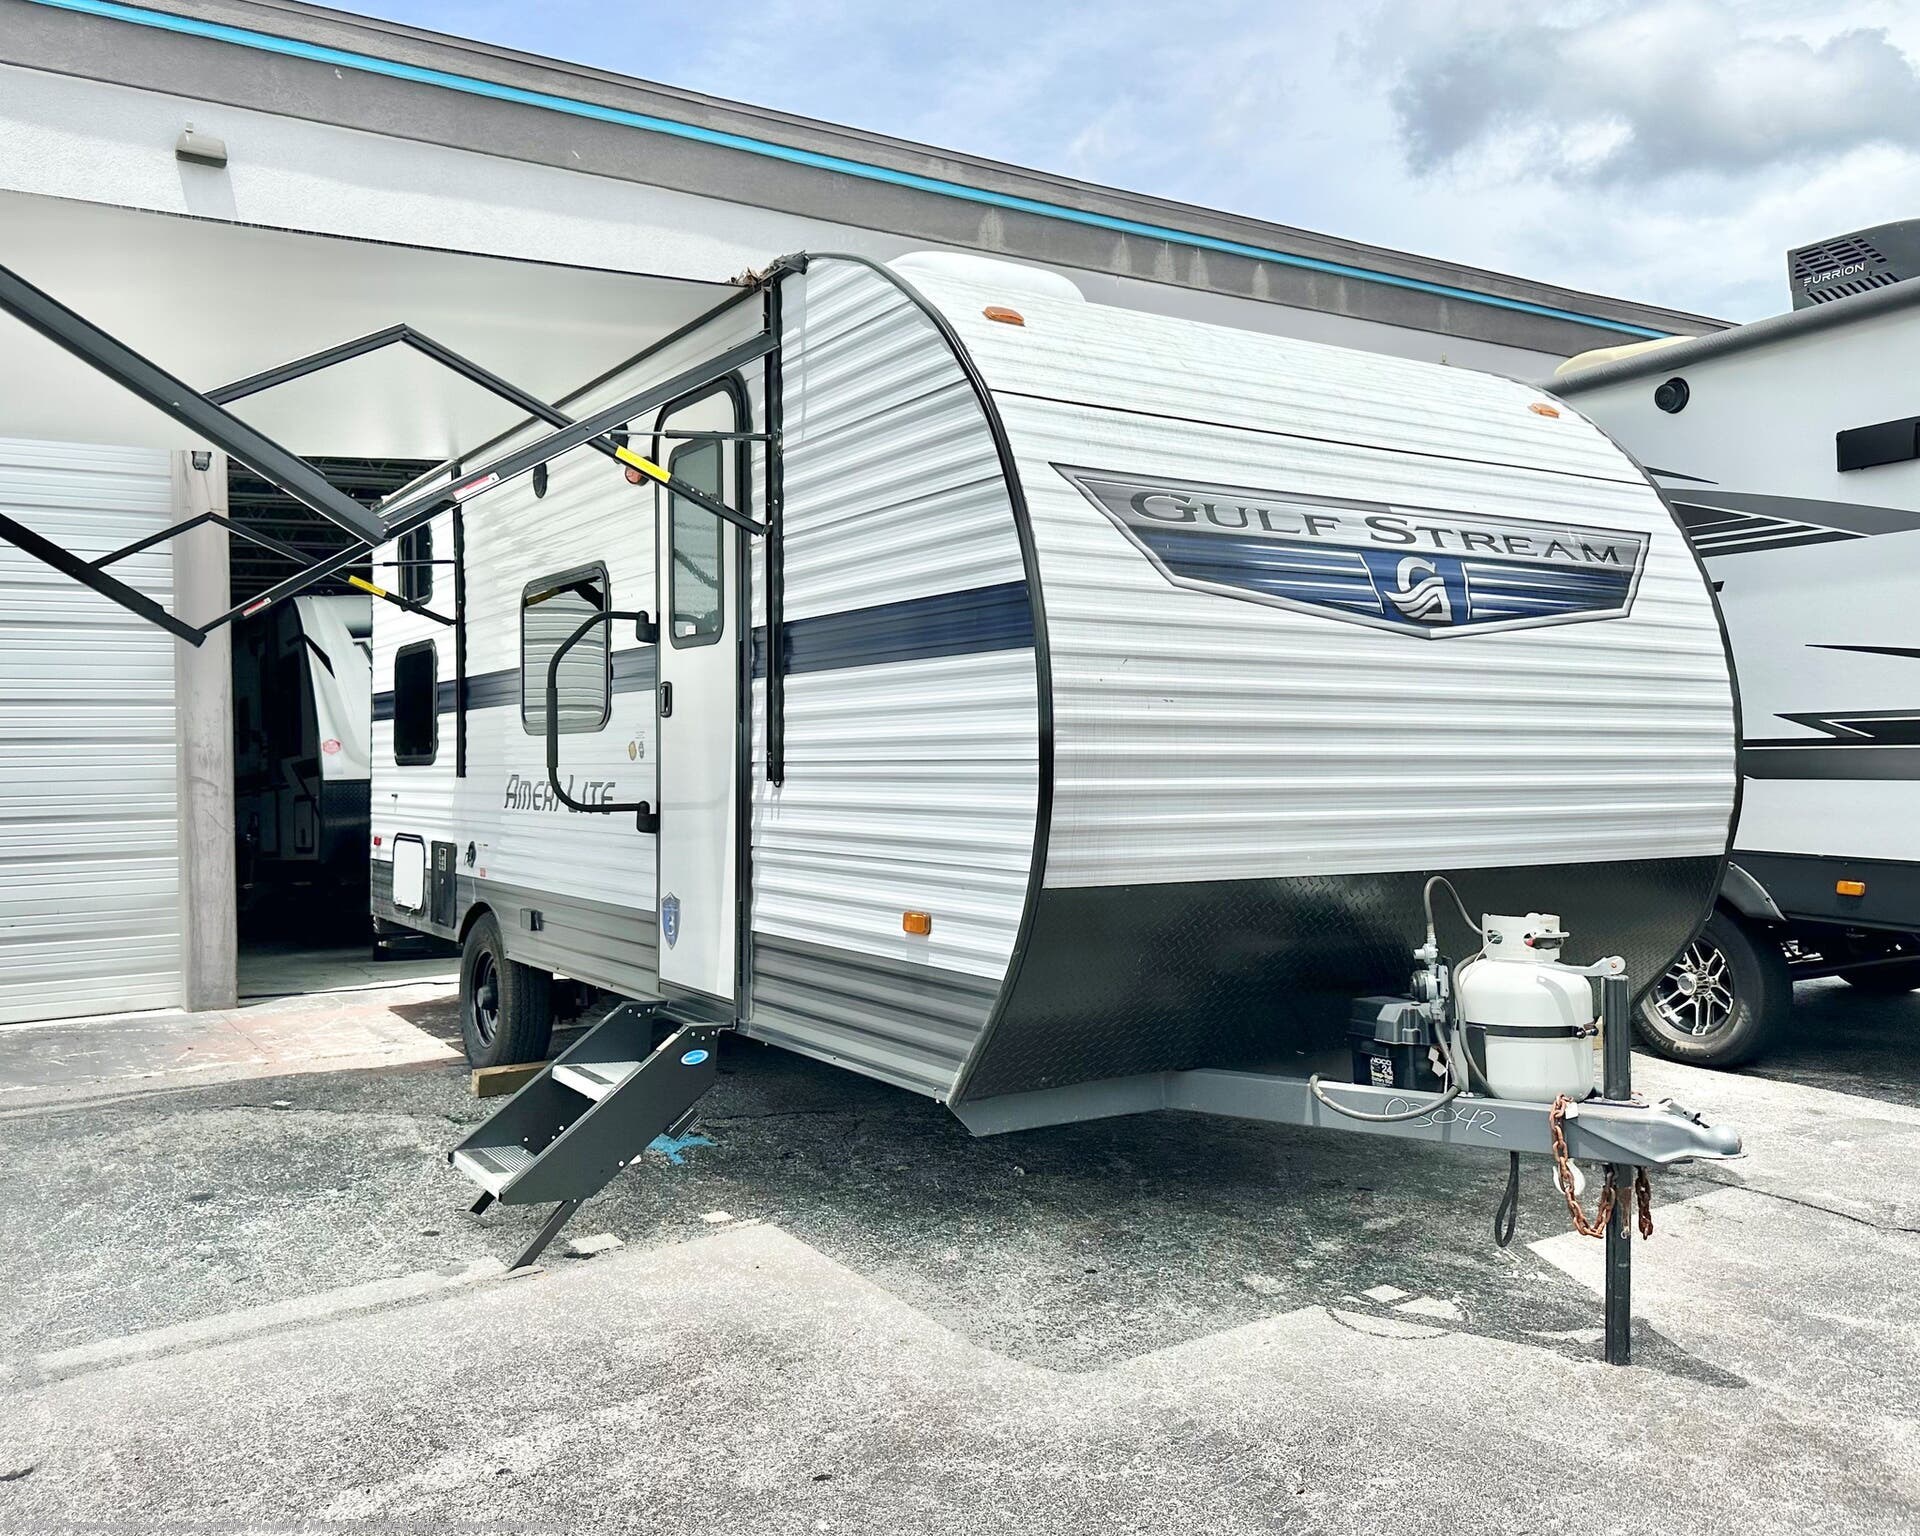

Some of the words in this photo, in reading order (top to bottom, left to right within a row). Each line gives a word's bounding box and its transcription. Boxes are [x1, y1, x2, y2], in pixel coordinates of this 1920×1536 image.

[1803, 262, 1865, 287] FURRION
[1130, 491, 1342, 537] GULF
[1364, 516, 1624, 566] STREAM
[1381, 1064, 1393, 1075] 24
